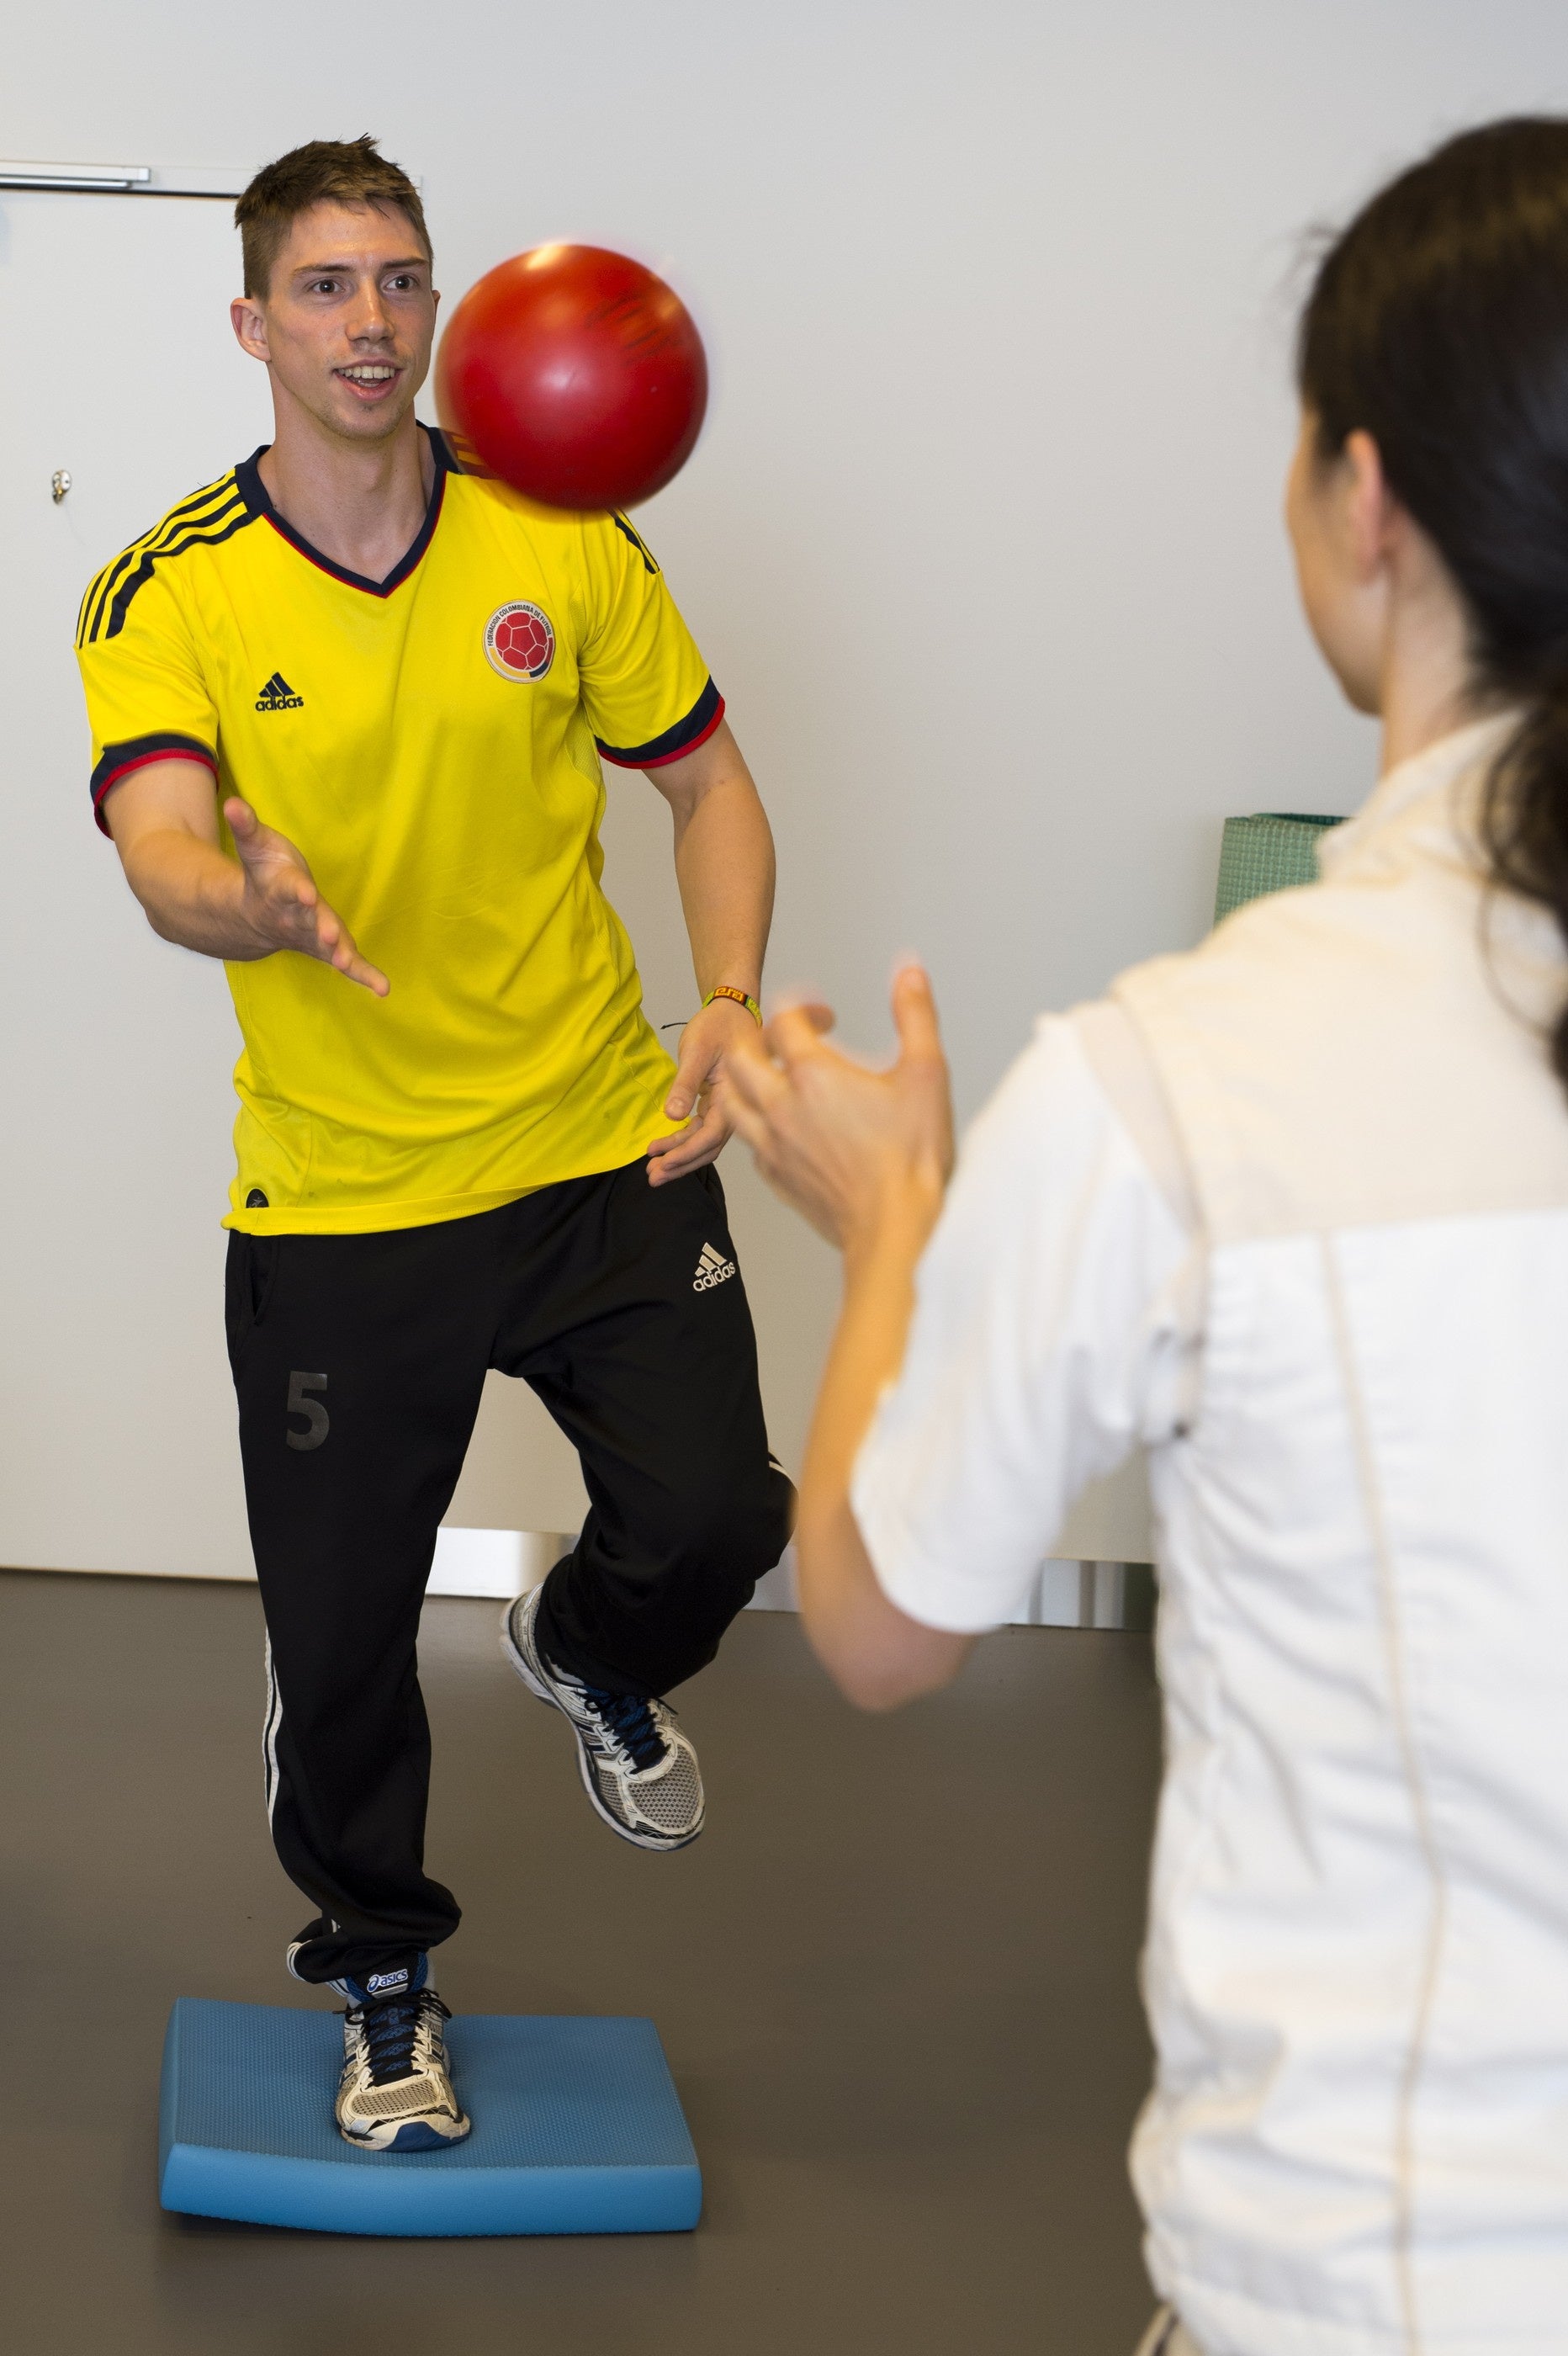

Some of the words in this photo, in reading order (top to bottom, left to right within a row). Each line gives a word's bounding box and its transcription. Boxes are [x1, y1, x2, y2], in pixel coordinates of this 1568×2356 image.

[500, 604, 533, 617] COLOMBIANA
[534, 610, 541, 618] DE
[540, 616, 552, 635] FUTBOL
[256, 695, 304, 711] adidas
[693, 1262, 735, 1292] adidas
[286, 1371, 330, 1451] 5
[380, 1970, 407, 1986] asics
